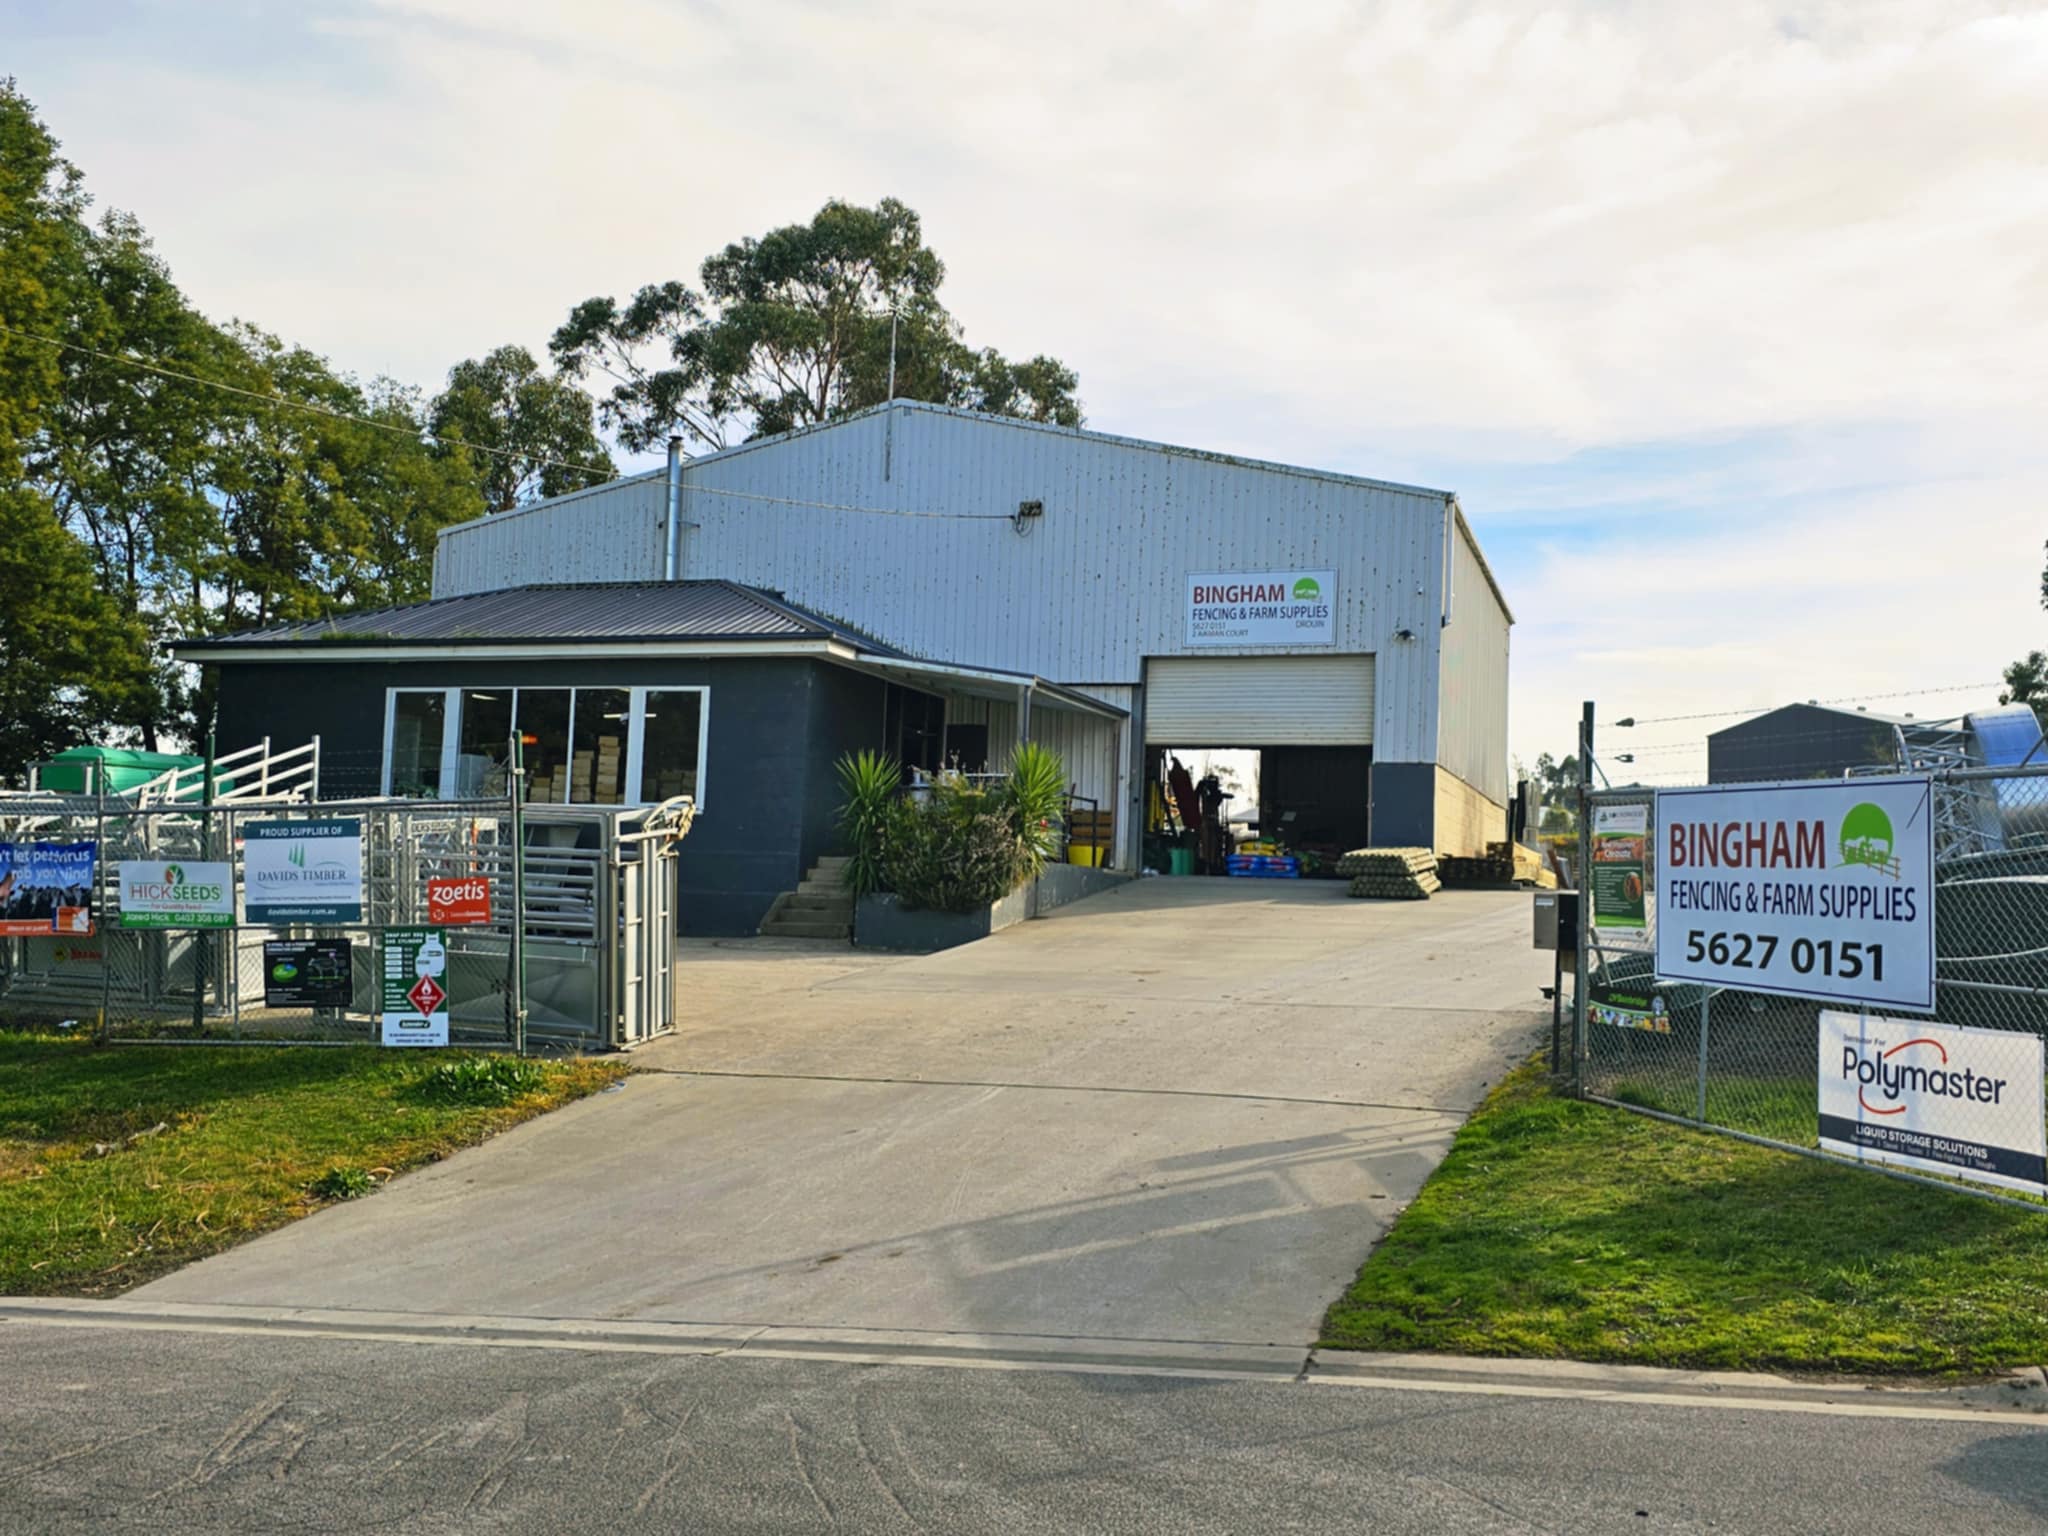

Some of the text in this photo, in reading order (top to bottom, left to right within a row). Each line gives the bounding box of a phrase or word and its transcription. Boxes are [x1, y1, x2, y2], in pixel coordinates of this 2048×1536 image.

[1193, 584, 1285, 604] BINGHAM
[1192, 605, 1329, 620] FENCING & FARM SUPPLIES
[1192, 622, 1226, 631] 5627 0151
[260, 826, 343, 837] PROUD SUPPLIER OF
[1669, 820, 1826, 870] BINGHAM
[13, 849, 30, 862] let
[11, 867, 33, 879] rob
[257, 870, 347, 881] DAVIDS TIMBER
[432, 881, 485, 906] zoetis
[1670, 880, 1916, 922] FENCING & FARM SUPPLIES
[1686, 930, 1883, 981] 5627 0151
[1842, 1046, 2007, 1104] Polymaster
[1855, 1124, 1888, 1140] LIQUID
[1889, 1131, 1932, 1148] STORAGE
[1933, 1138, 1988, 1160] SOLUTIONS
